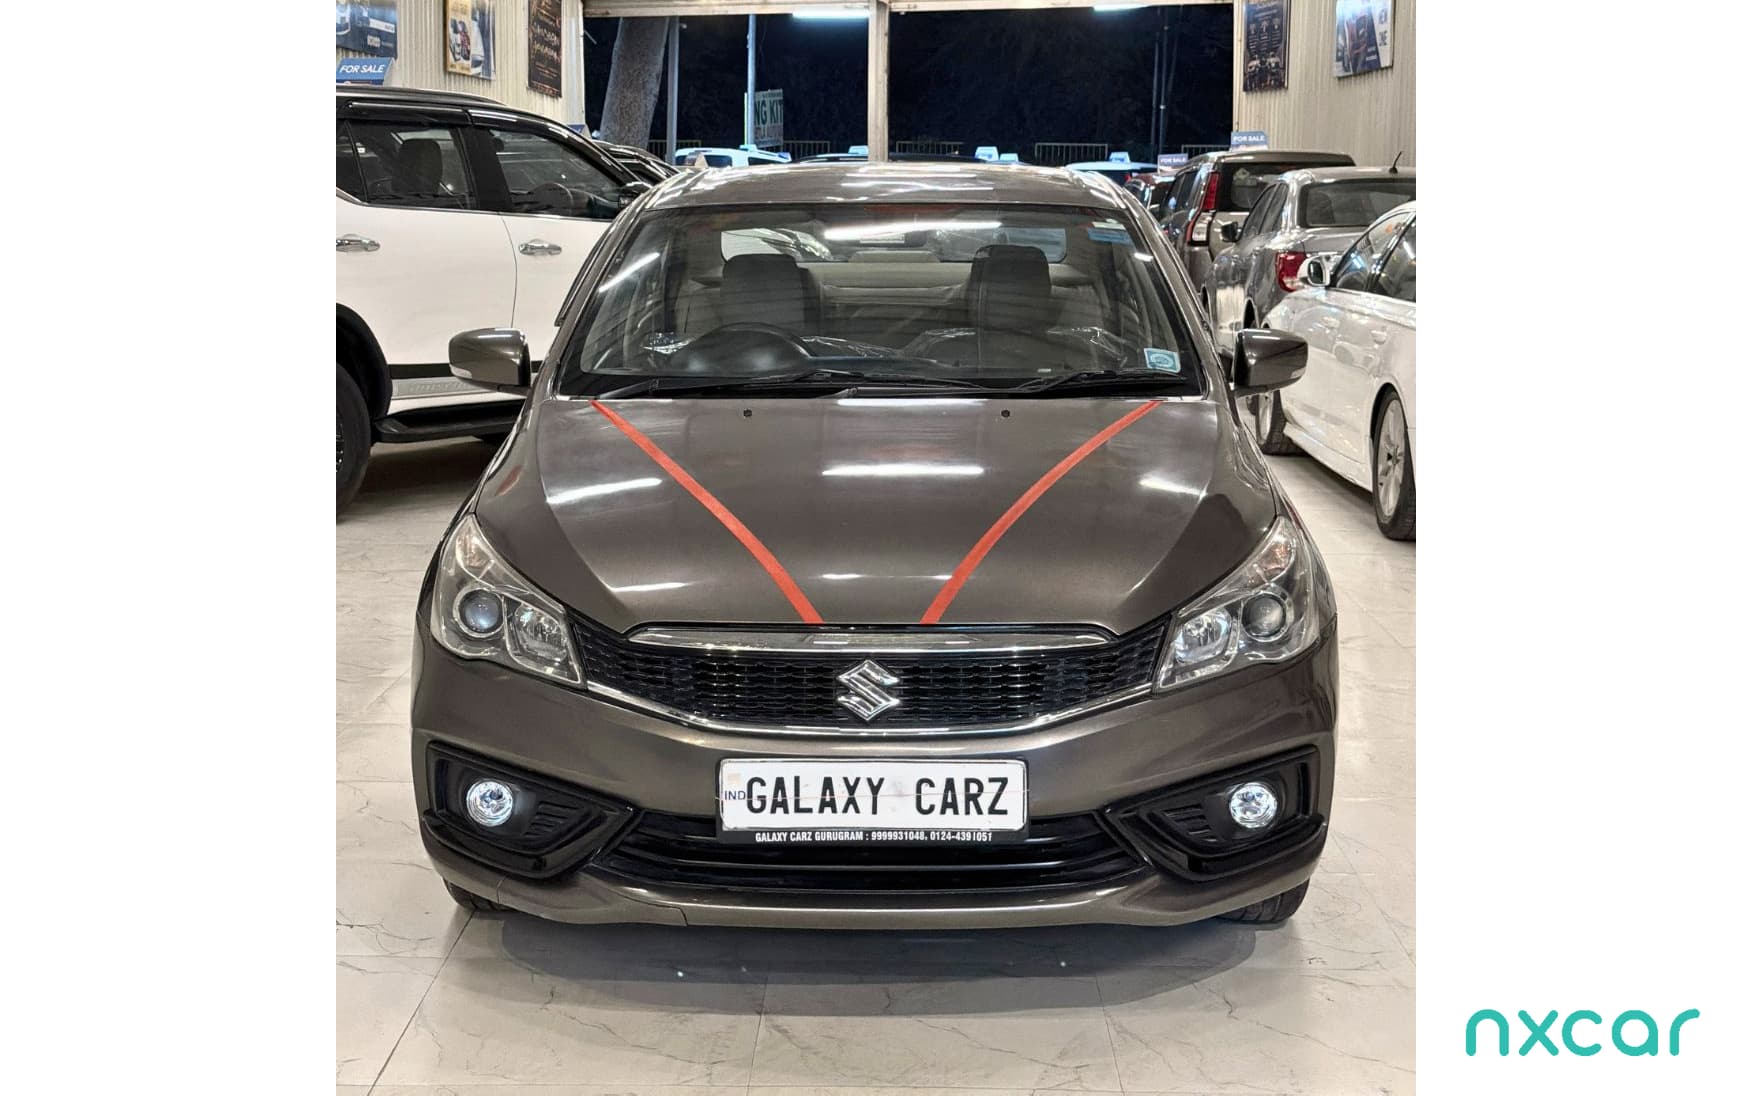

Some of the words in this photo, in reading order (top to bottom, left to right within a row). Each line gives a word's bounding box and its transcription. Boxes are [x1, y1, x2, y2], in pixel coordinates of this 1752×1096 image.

[339, 64, 360, 73] FOR
[360, 64, 385, 73] SALE
[724, 790, 746, 801] IND
[746, 775, 885, 815] GALAXY
[915, 777, 1009, 815] CARZ
[755, 831, 787, 842] GALAXY
[790, 831, 812, 842] CARZ
[815, 830, 864, 841] GURUGRAM
[930, 830, 993, 842] 0124-4391051
